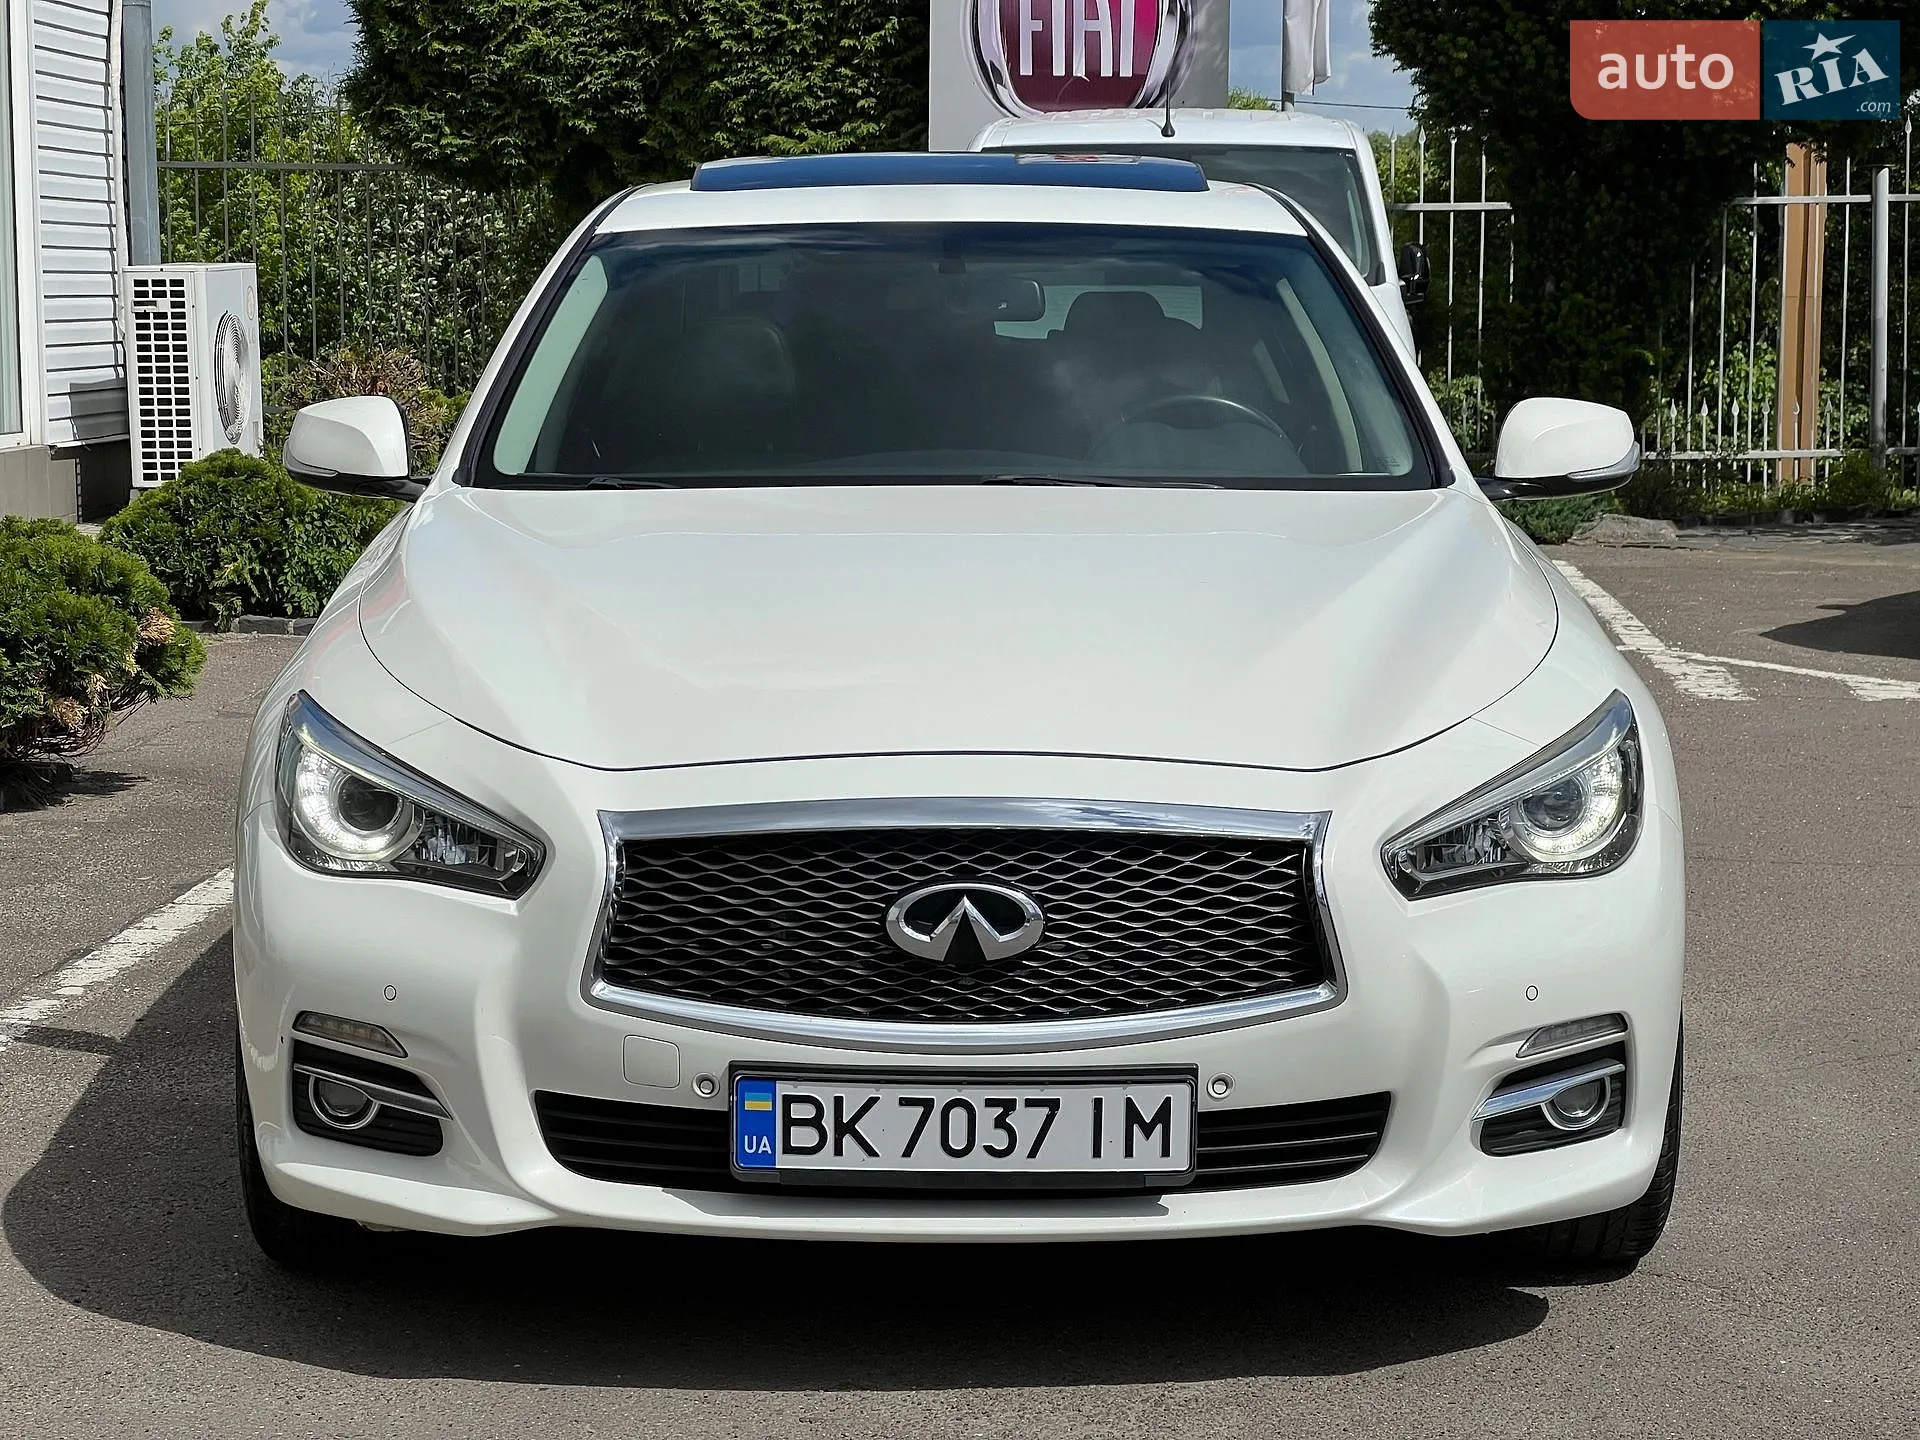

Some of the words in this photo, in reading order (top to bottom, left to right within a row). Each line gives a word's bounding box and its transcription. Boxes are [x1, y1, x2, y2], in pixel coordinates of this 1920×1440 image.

[744, 1135, 772, 1154] UA
[781, 1093, 880, 1158] BK
[898, 1096, 1062, 1158] 7037
[1092, 1096, 1172, 1158] IM
